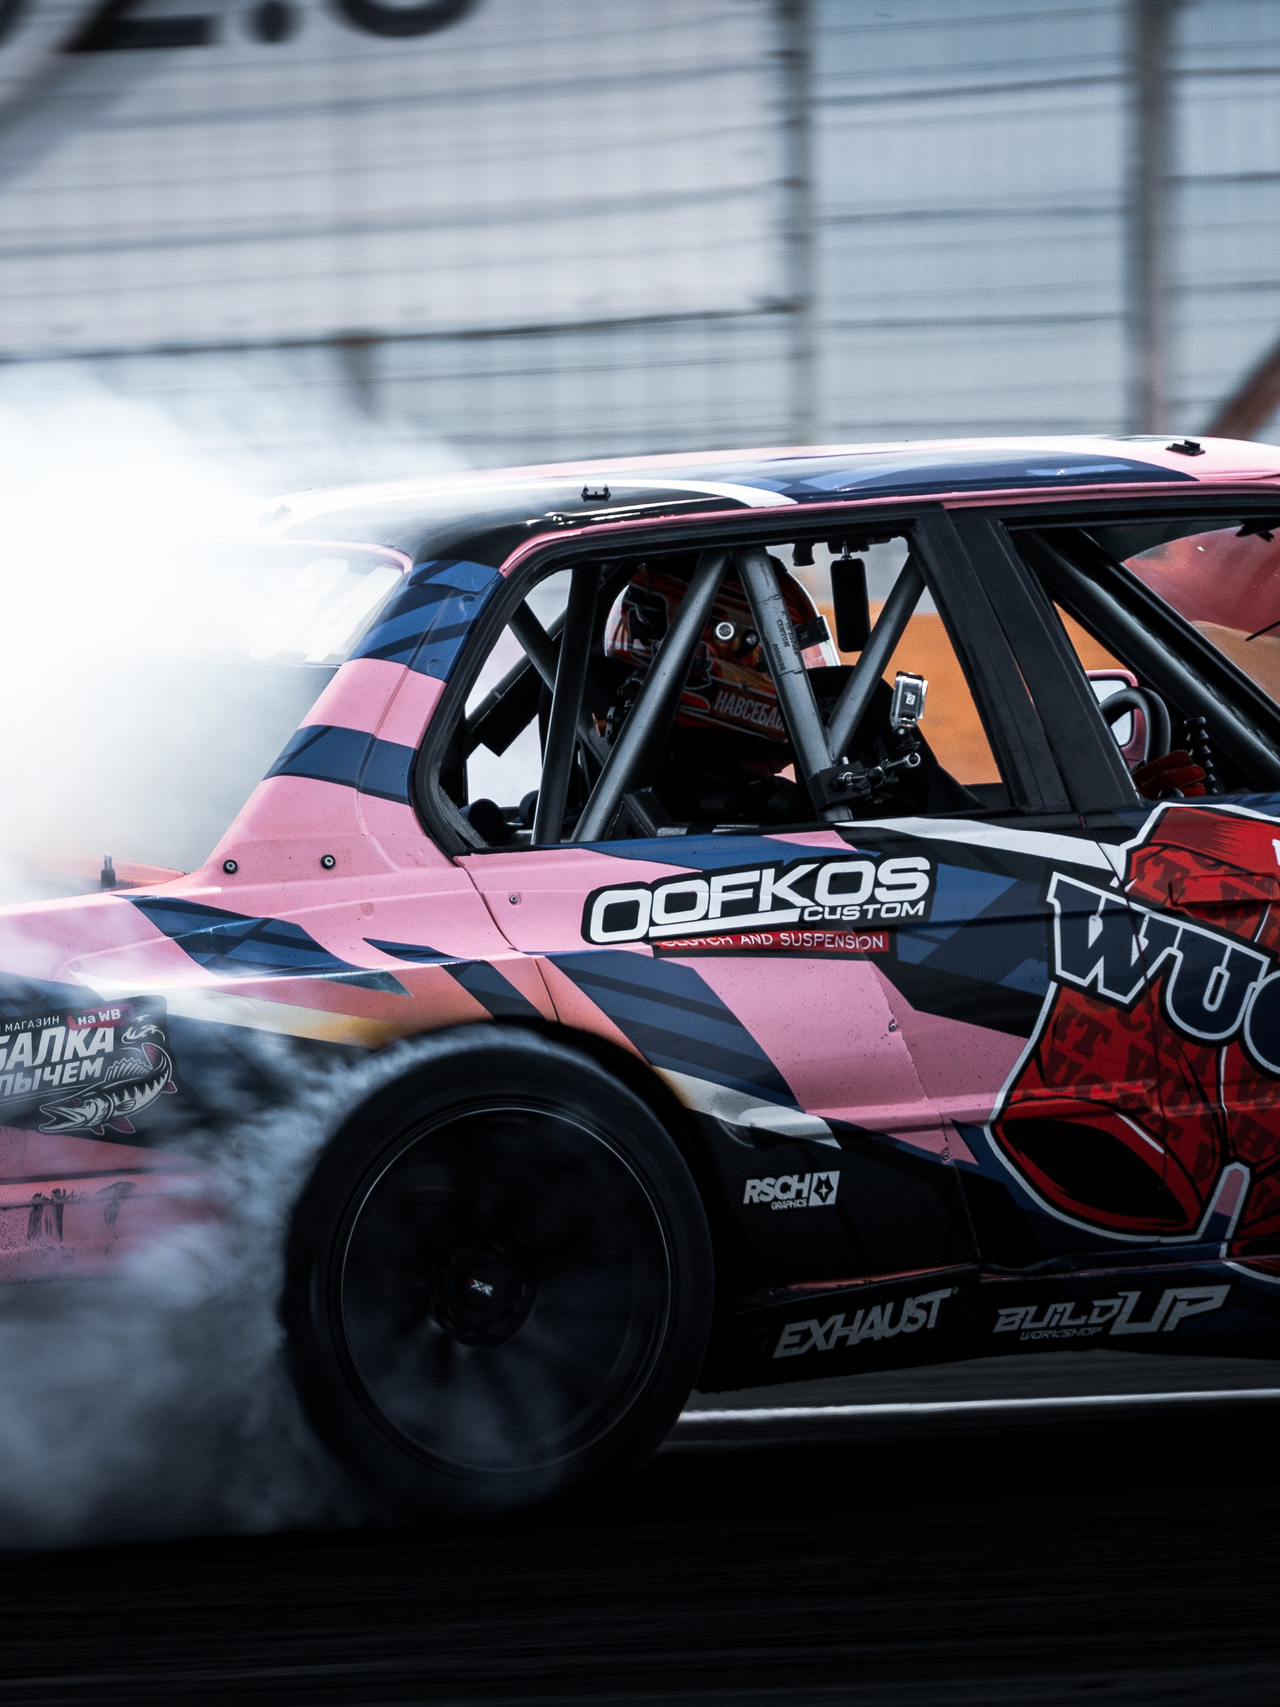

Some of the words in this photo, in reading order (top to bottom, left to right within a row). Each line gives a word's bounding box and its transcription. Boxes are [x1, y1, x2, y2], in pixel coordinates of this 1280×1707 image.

[803, 900, 925, 921] CUSTOM
[740, 933, 774, 945] AND
[779, 932, 883, 950] SUSPENSION
[5, 1015, 60, 1033] МАГАЗИН
[98, 1008, 121, 1024] WB
[743, 1173, 812, 1205] RSCH
[770, 1198, 808, 1212] GRAPHICS
[772, 1287, 954, 1359] EXHAUST
[1020, 1326, 1103, 1341] WORKSHOP
